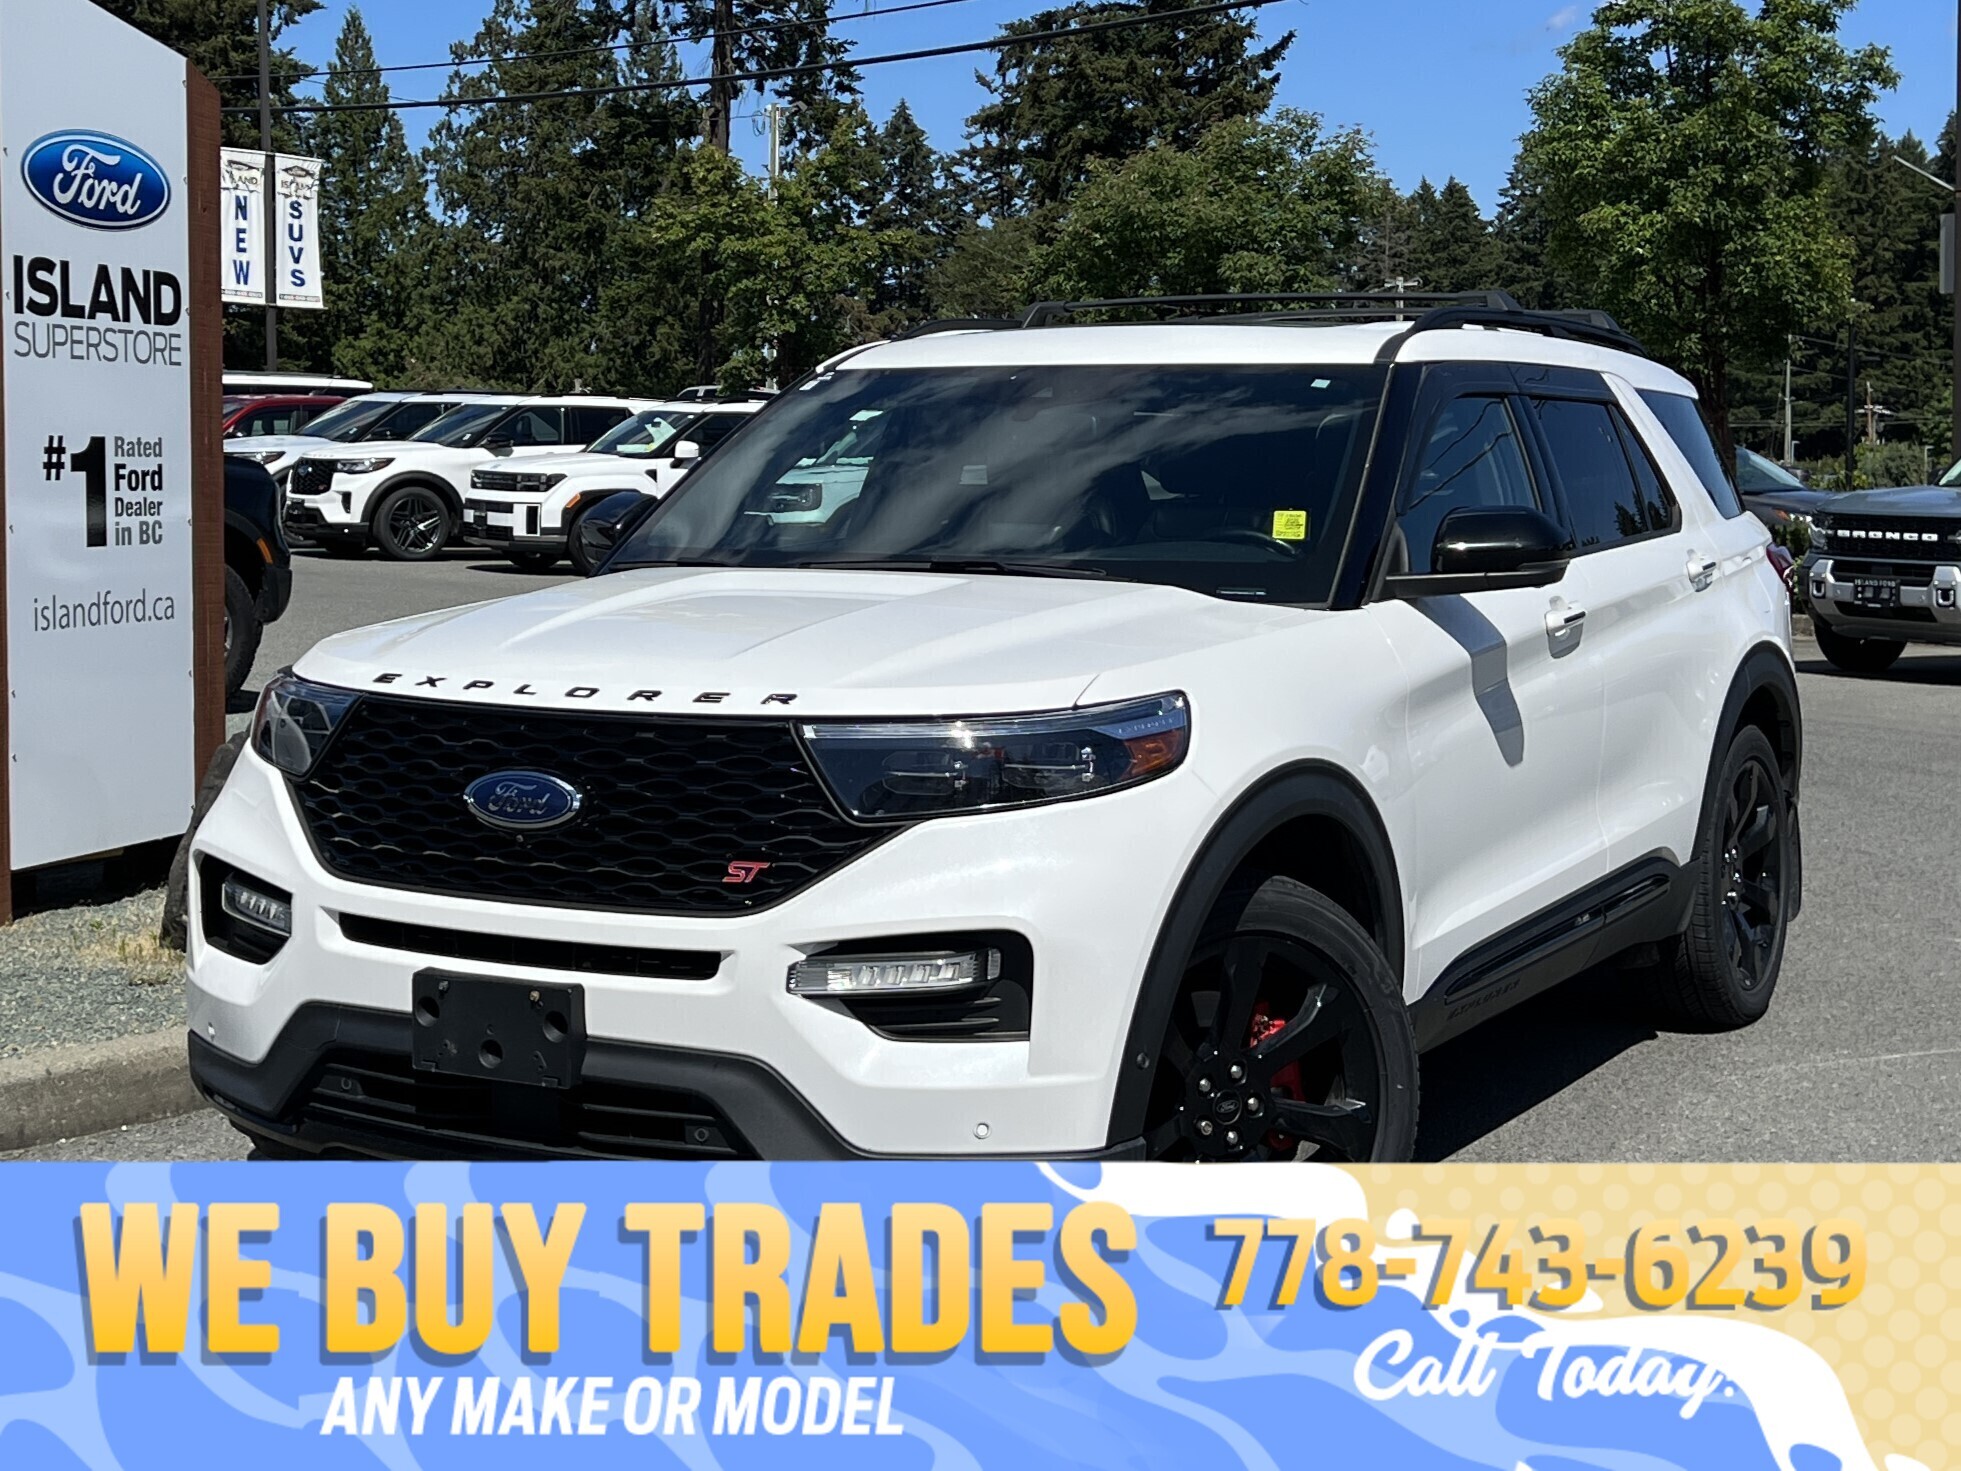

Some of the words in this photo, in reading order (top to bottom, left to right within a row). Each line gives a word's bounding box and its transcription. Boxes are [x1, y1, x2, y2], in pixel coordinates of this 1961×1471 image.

[53, 144, 143, 215] Ford
[232, 195, 250, 285] NEW
[288, 200, 306, 287] SUVS
[12, 254, 182, 327] ISLAND
[14, 321, 182, 367] SUPERSTORE
[114, 436, 163, 458] Rated
[43, 434, 107, 548] #1
[114, 463, 163, 492] Ford
[114, 497, 163, 518] Dealer
[115, 521, 132, 546] in
[138, 519, 163, 546] BC
[1837, 529, 1938, 542] BRONCO
[33, 588, 175, 632] islandford.ca
[373, 673, 798, 705] EXPLORER
[488, 781, 551, 815] Ford
[722, 861, 770, 883] ST
